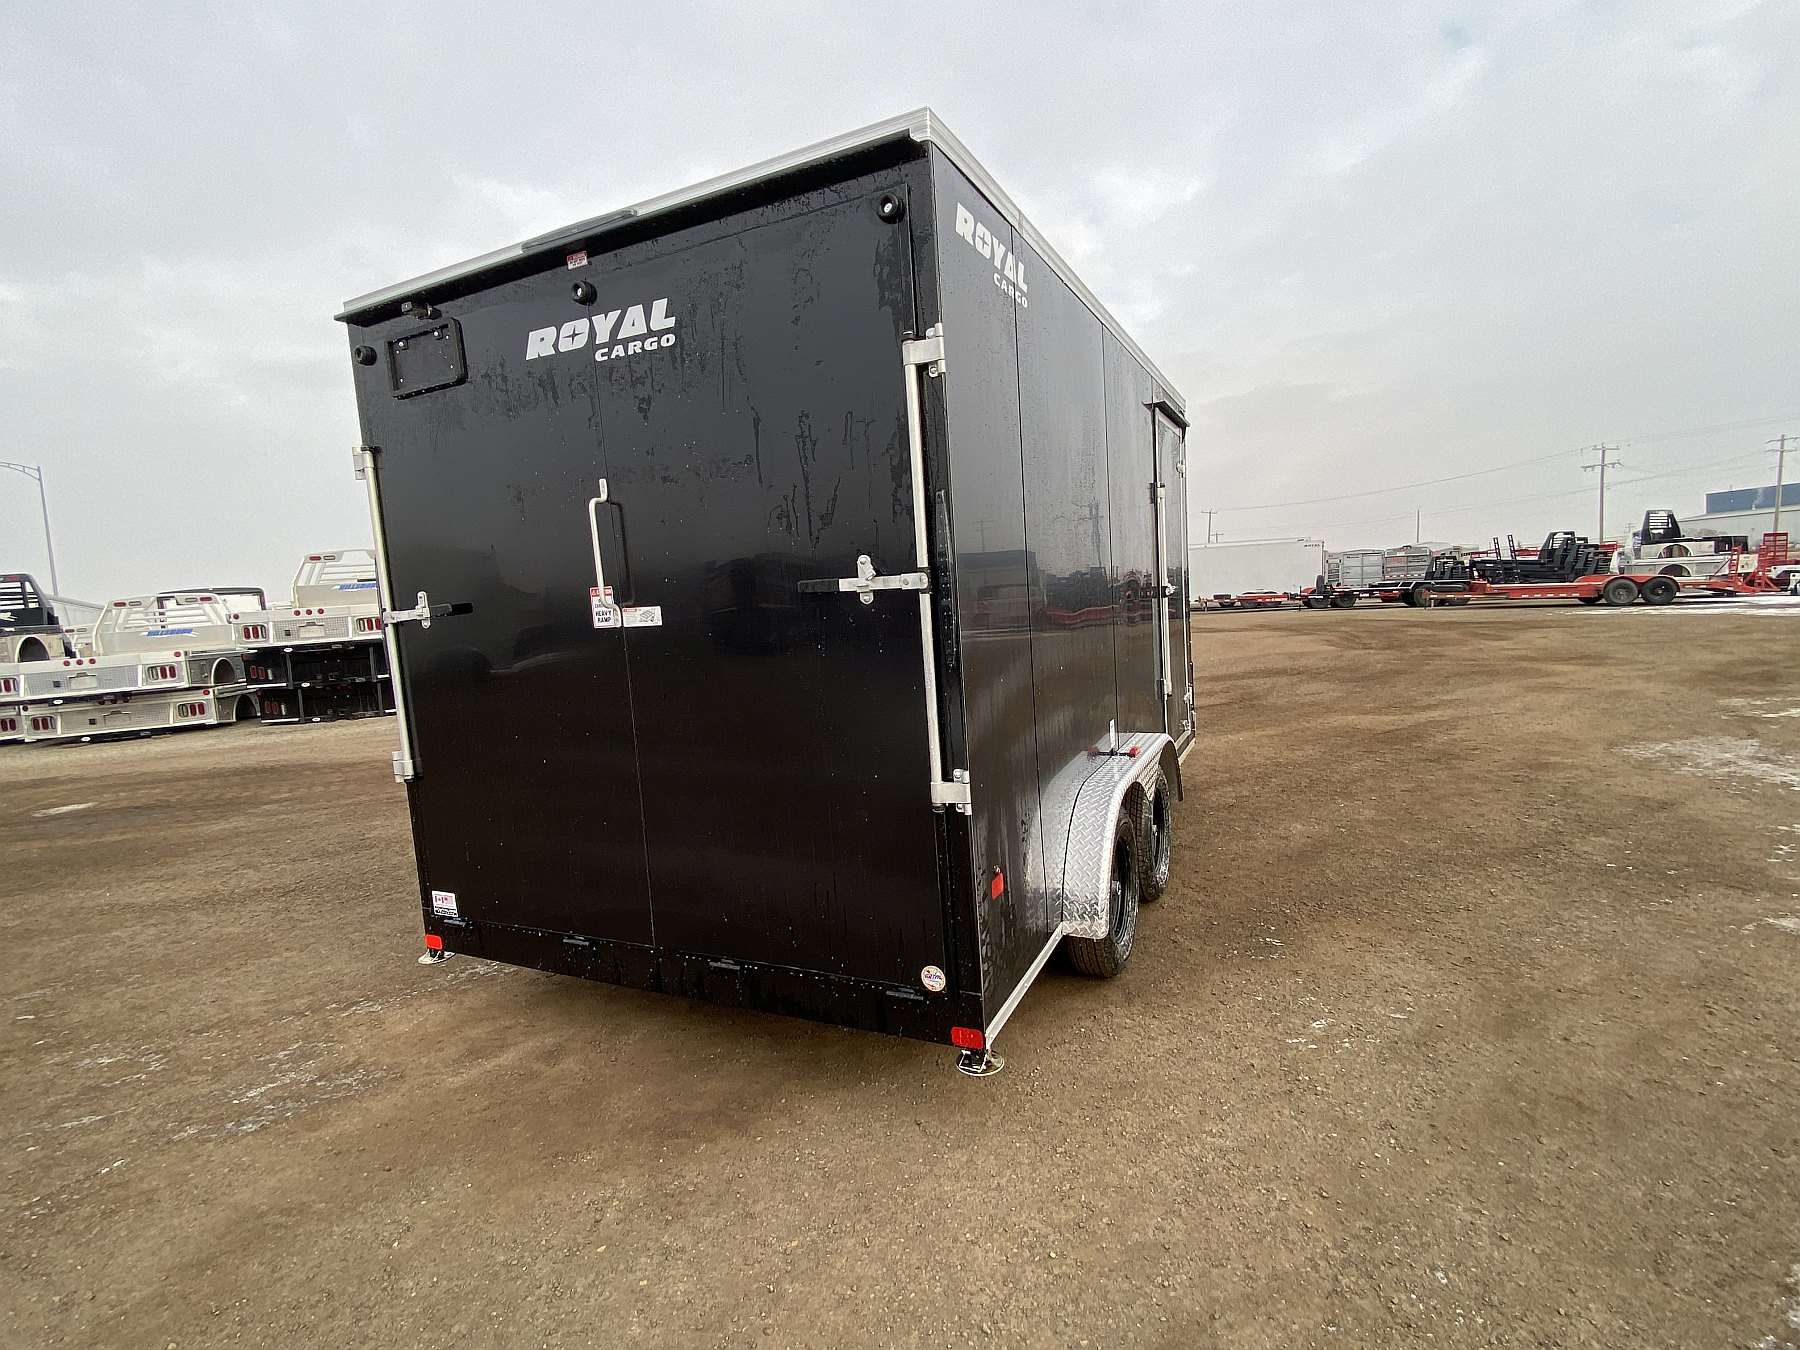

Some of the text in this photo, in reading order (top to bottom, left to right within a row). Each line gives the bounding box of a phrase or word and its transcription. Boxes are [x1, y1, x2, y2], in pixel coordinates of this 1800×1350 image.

[955, 202, 1028, 293] ROYAL
[993, 272, 1028, 308] CARGO
[526, 297, 676, 360] ROYAL
[595, 333, 676, 362] CARGO
[595, 609, 612, 617] HEAVY
